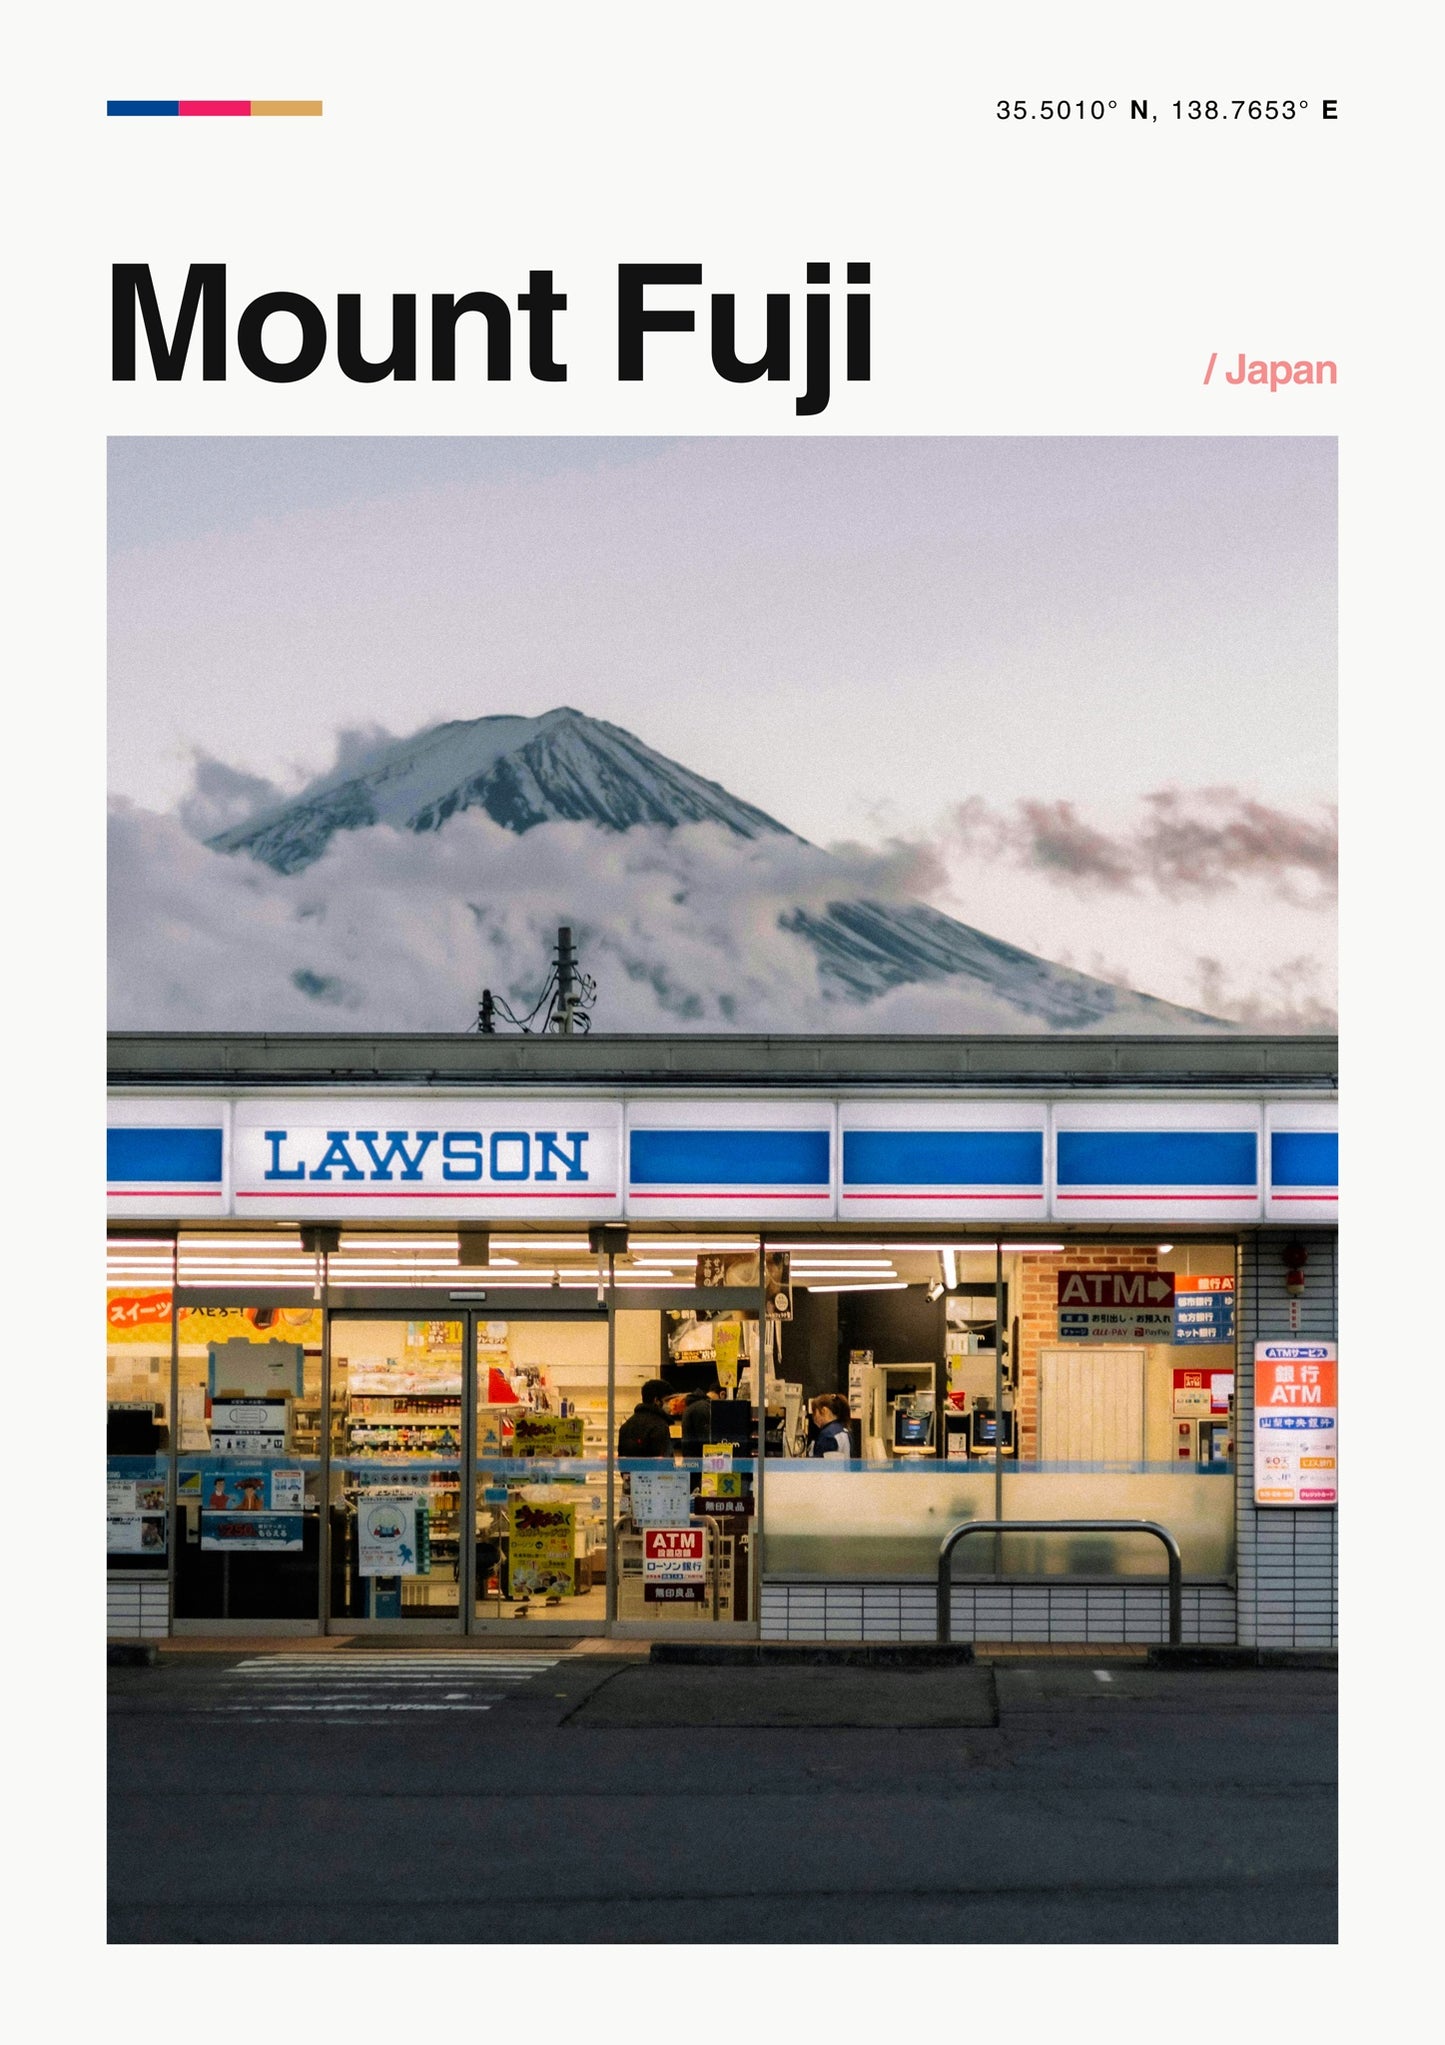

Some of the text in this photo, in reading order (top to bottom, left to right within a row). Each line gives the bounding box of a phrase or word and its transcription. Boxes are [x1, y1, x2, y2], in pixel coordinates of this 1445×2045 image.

[264, 1131, 589, 1181] LAWSON
[1061, 1274, 1145, 1303] ATM
[111, 1301, 172, 1322] スイーツ
[1091, 1313, 1171, 1323] お引出し・お預入れ
[1178, 1312, 1213, 1322] 地方銀行
[1145, 1329, 1170, 1337] PayPay
[1177, 1328, 1217, 1338] ネット銀行
[1269, 1348, 1325, 1357] ATMサービス
[1275, 1365, 1320, 1383] 銀行
[1270, 1385, 1321, 1403] ATM
[1261, 1418, 1331, 1428] 山梨中央銀行
[706, 1501, 747, 1512] 無印良品
[653, 1533, 695, 1548] ATM
[647, 1562, 701, 1571] ローソン銀行
[655, 1588, 695, 1598] 無印良品
